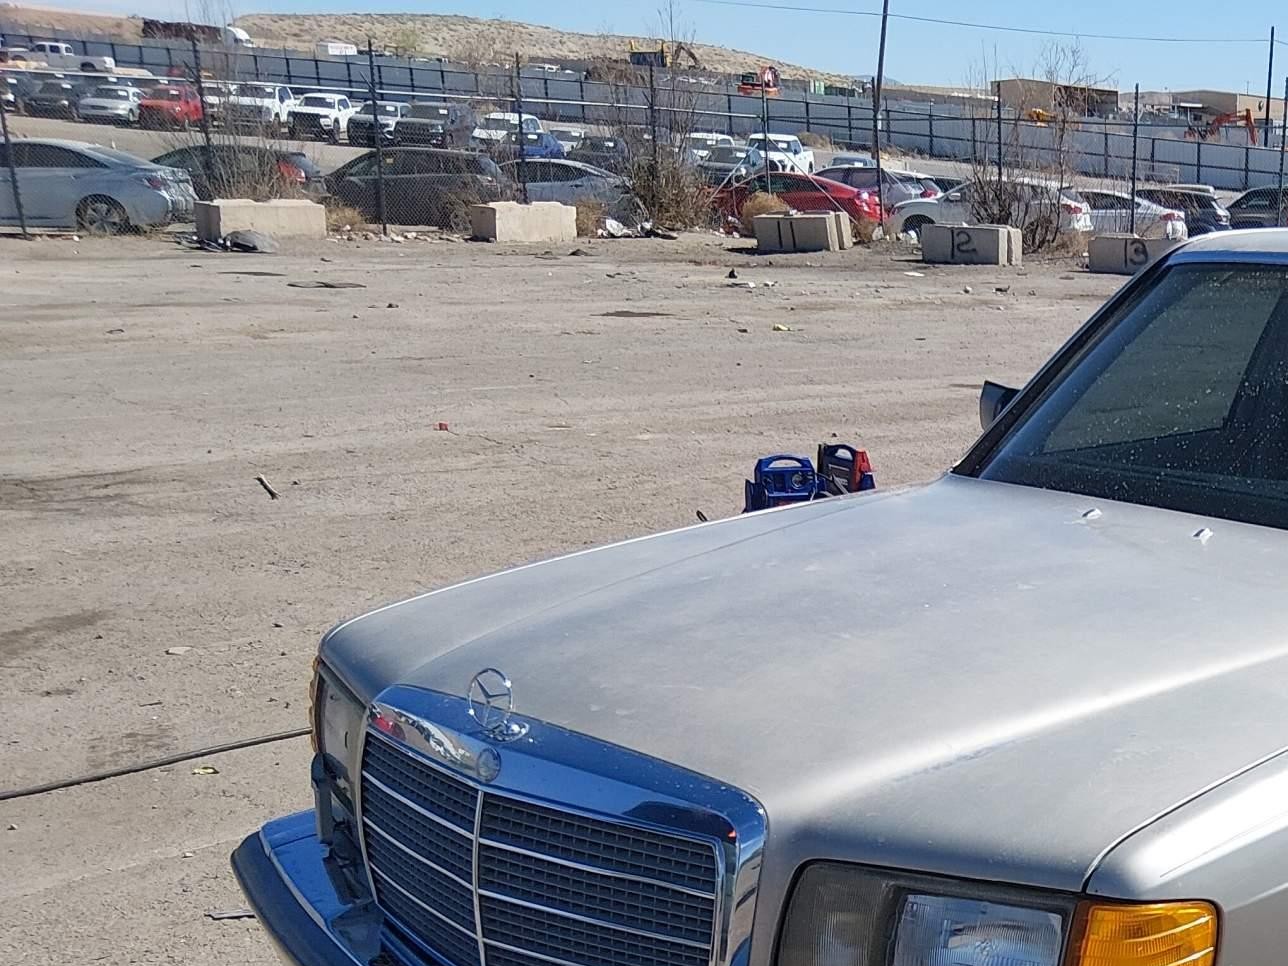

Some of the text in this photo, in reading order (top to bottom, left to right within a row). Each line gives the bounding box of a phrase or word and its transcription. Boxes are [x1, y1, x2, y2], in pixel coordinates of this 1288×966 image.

[777, 220, 797, 249] 11
[951, 229, 976, 260] 12
[1124, 238, 1149, 269] 13
